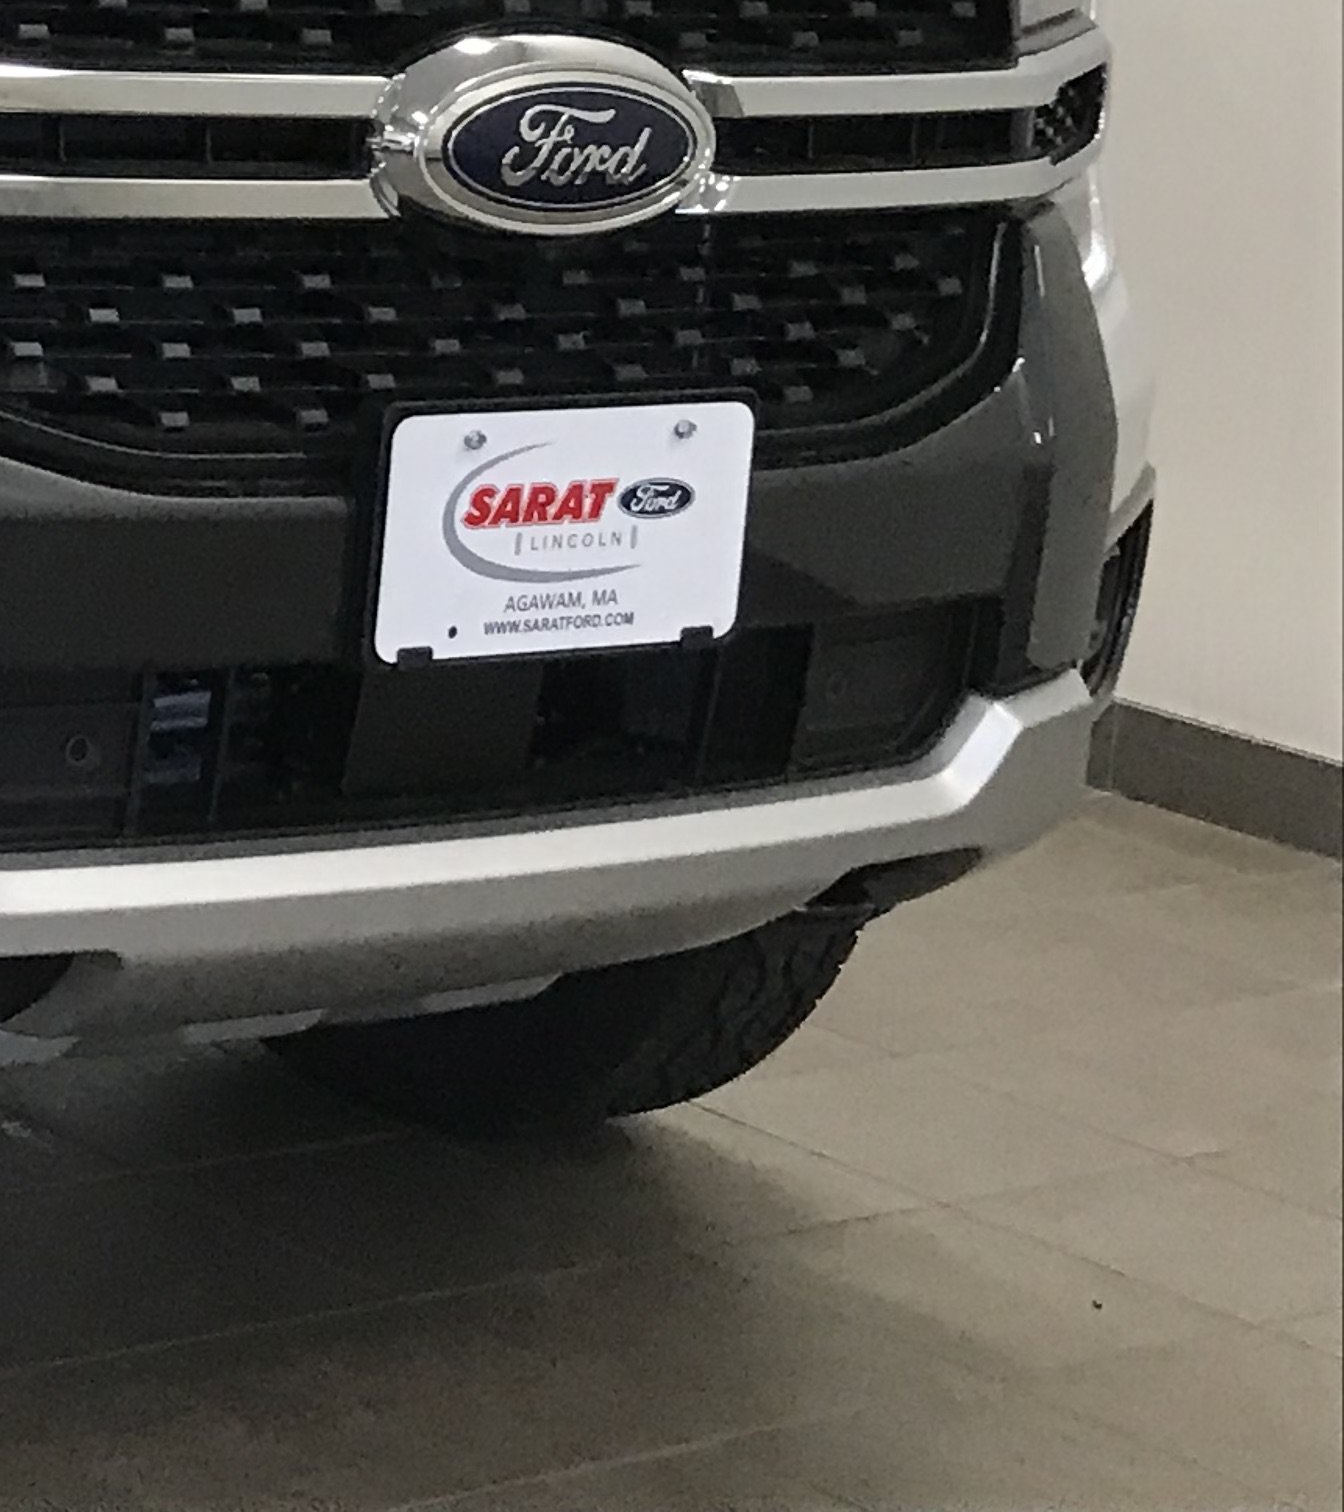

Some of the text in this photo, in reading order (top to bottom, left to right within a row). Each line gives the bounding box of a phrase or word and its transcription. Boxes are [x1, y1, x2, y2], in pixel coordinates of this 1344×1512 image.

[502, 104, 652, 187] Ford
[462, 478, 682, 529] SARAT Ford
[530, 532, 622, 551] LINCOLN
[503, 589, 618, 613] AGAWAM, MA
[483, 611, 635, 635] WWW.SARATFORD.COM
